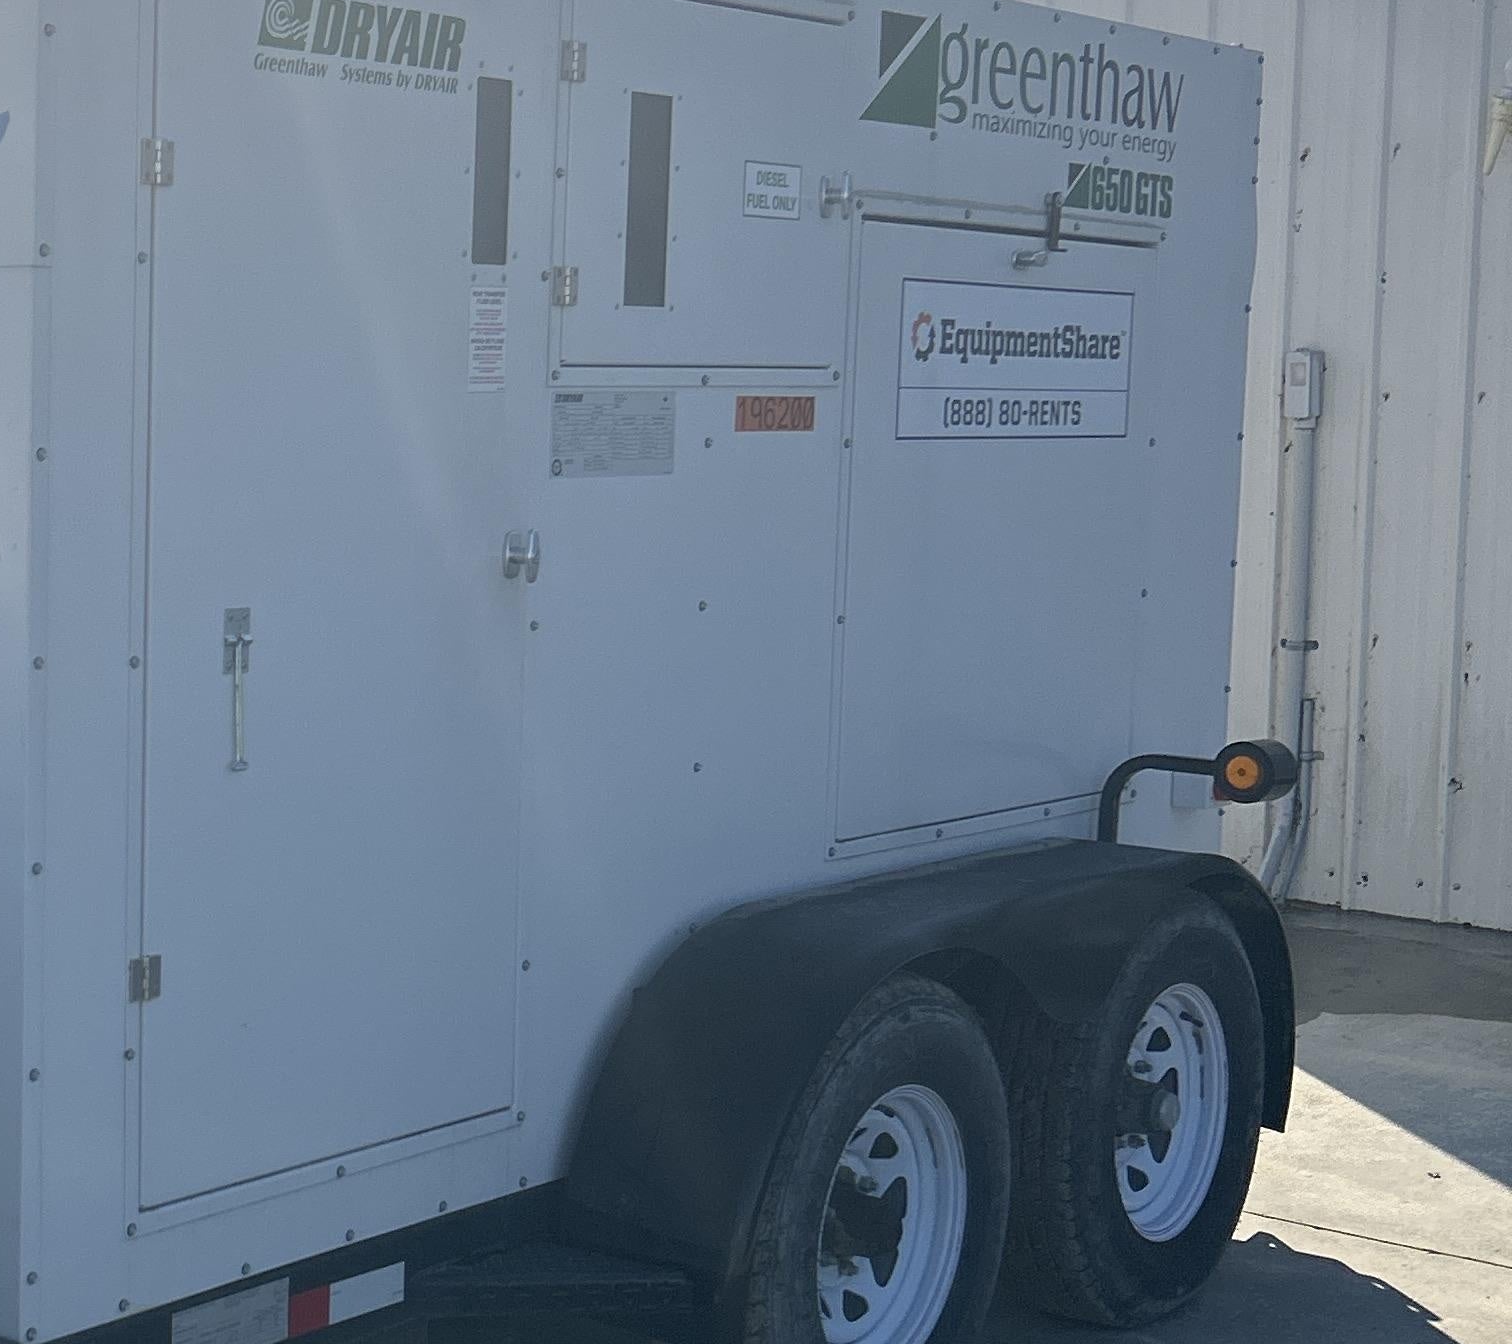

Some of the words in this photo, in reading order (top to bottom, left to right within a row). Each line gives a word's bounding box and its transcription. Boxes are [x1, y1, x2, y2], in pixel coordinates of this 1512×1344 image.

[253, 52, 328, 78] Greenthaw
[340, 63, 392, 86] Systems
[395, 70, 413, 91] by
[414, 73, 459, 94] DRYAIR
[939, 22, 1184, 133] greenthaw
[972, 111, 1073, 149] maximizing
[1079, 127, 1118, 151] your
[1122, 132, 1177, 162] energy
[756, 170, 790, 188] DIESEL
[746, 193, 770, 210] FUEL
[772, 195, 797, 211] ONLY
[939, 318, 1121, 364] EquipmentShare
[738, 396, 815, 430] 196200
[943, 397, 992, 428] (888)
[998, 400, 1081, 427] 80-RENTS
